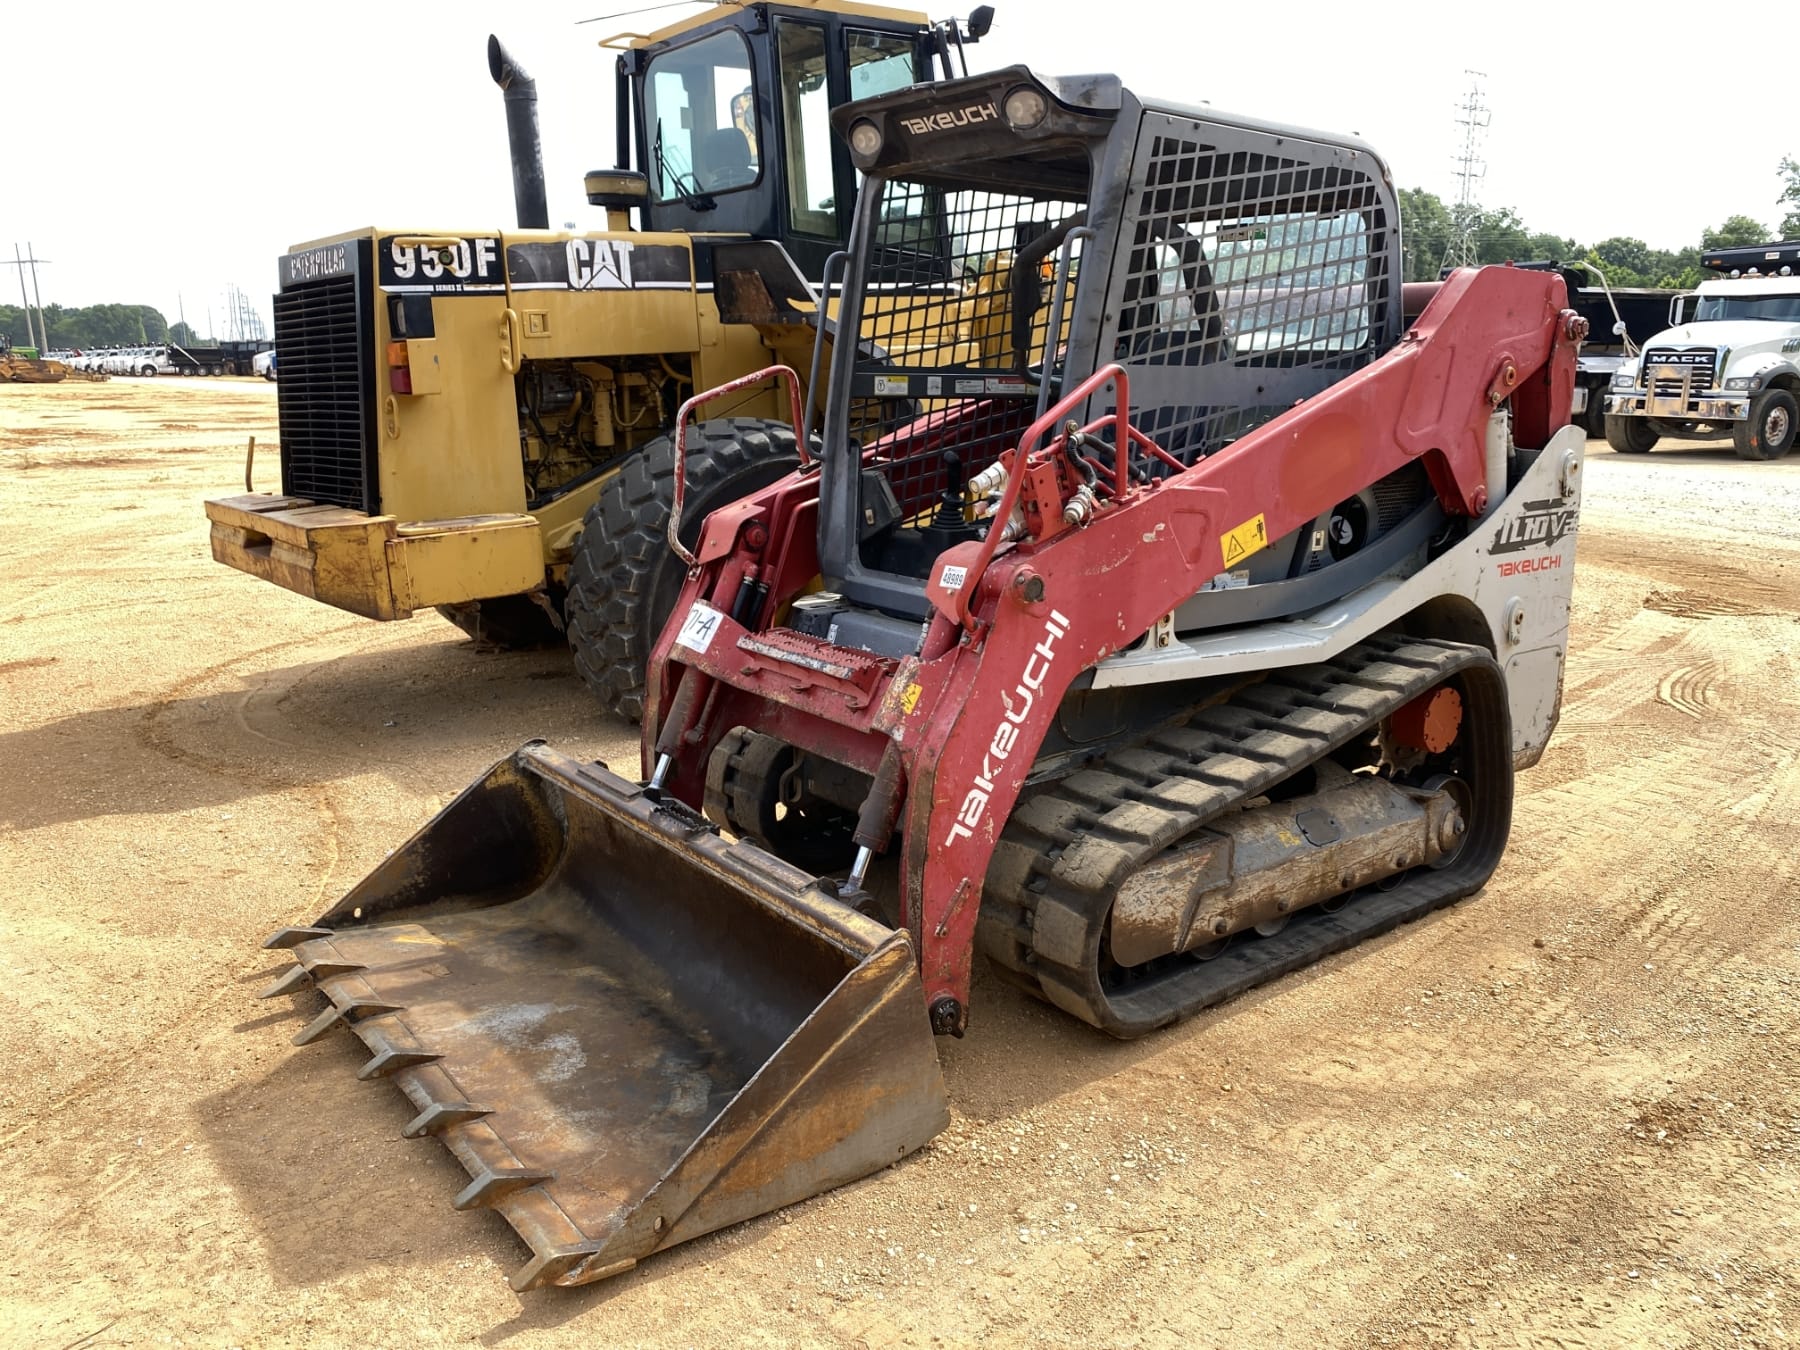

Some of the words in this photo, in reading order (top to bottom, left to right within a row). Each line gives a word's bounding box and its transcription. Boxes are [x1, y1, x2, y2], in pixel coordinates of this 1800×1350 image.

[391, 237, 497, 278] 950F
[566, 239, 634, 289] CAT
[1652, 355, 1710, 363] MACK
[1497, 555, 1562, 578] TAKEUCHI
